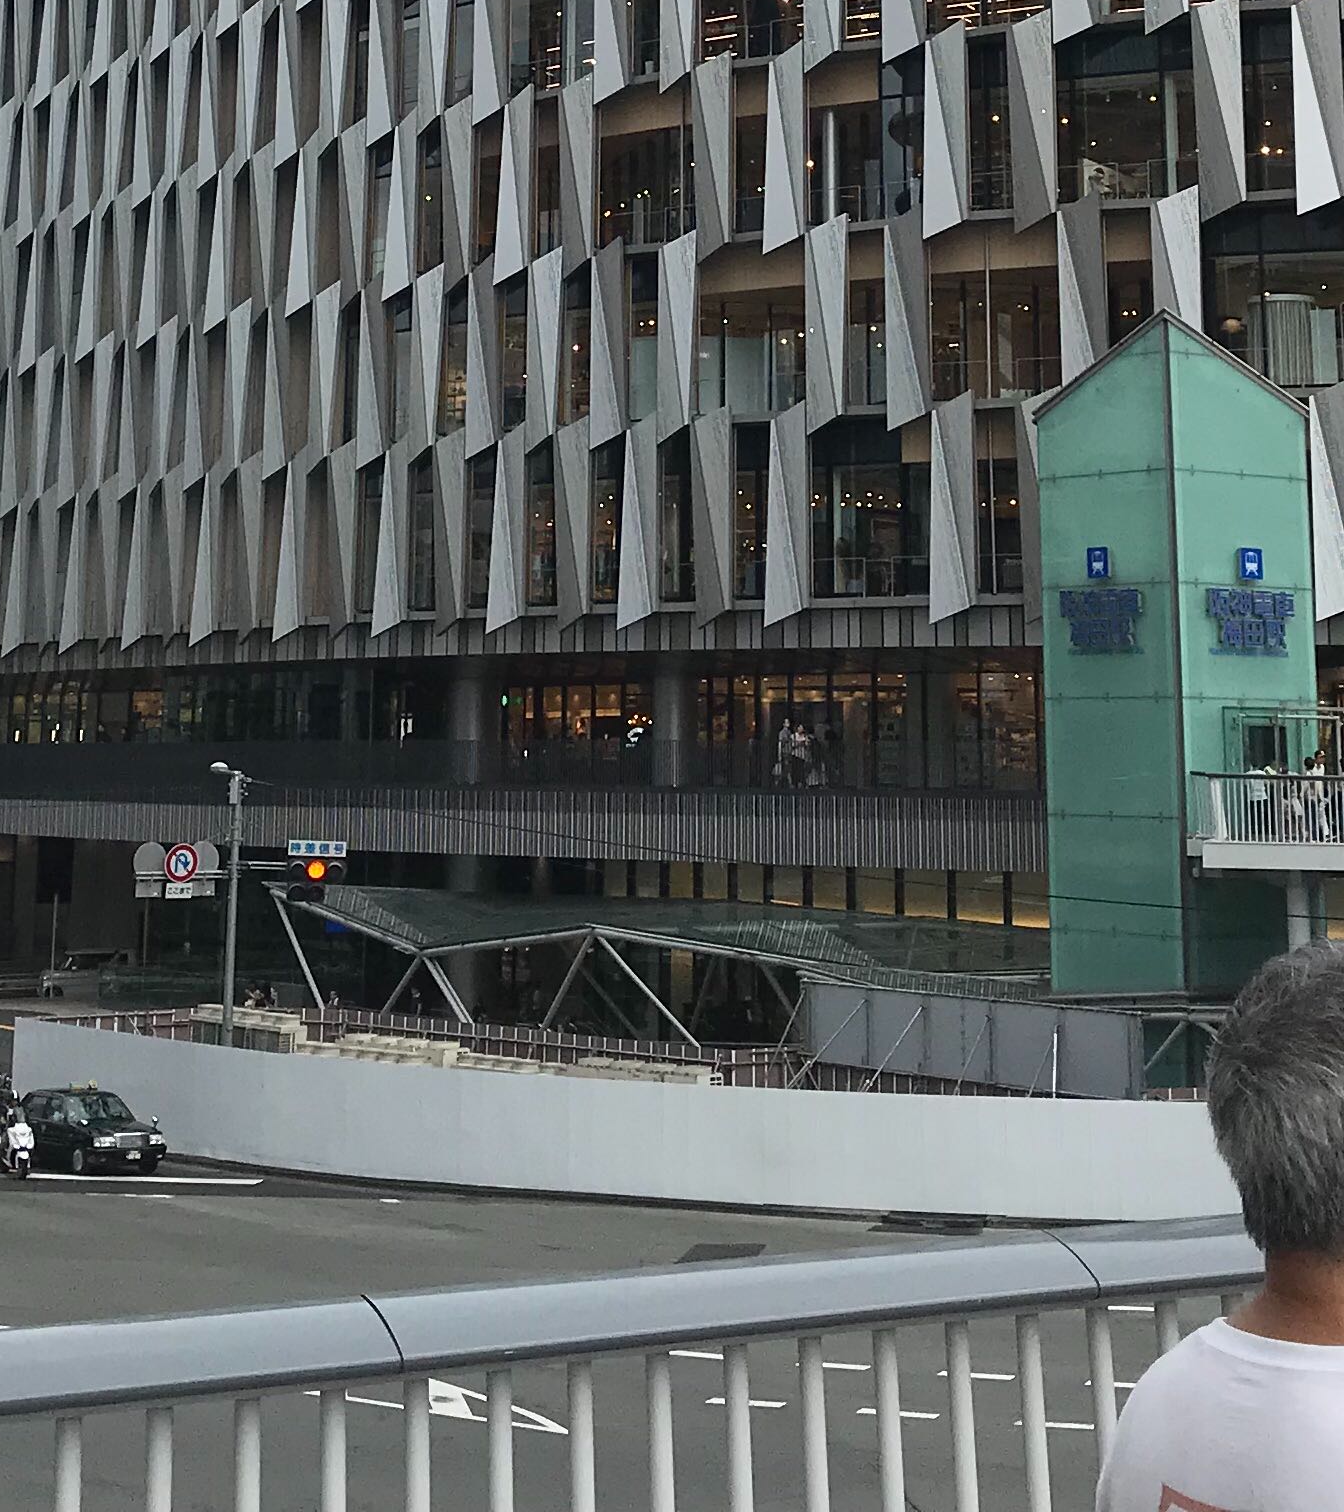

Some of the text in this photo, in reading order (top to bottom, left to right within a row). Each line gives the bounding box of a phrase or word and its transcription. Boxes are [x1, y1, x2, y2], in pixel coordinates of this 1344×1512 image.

[1206, 588, 1295, 618] 阪神電車
[1220, 618, 1287, 648] 梅田駅
